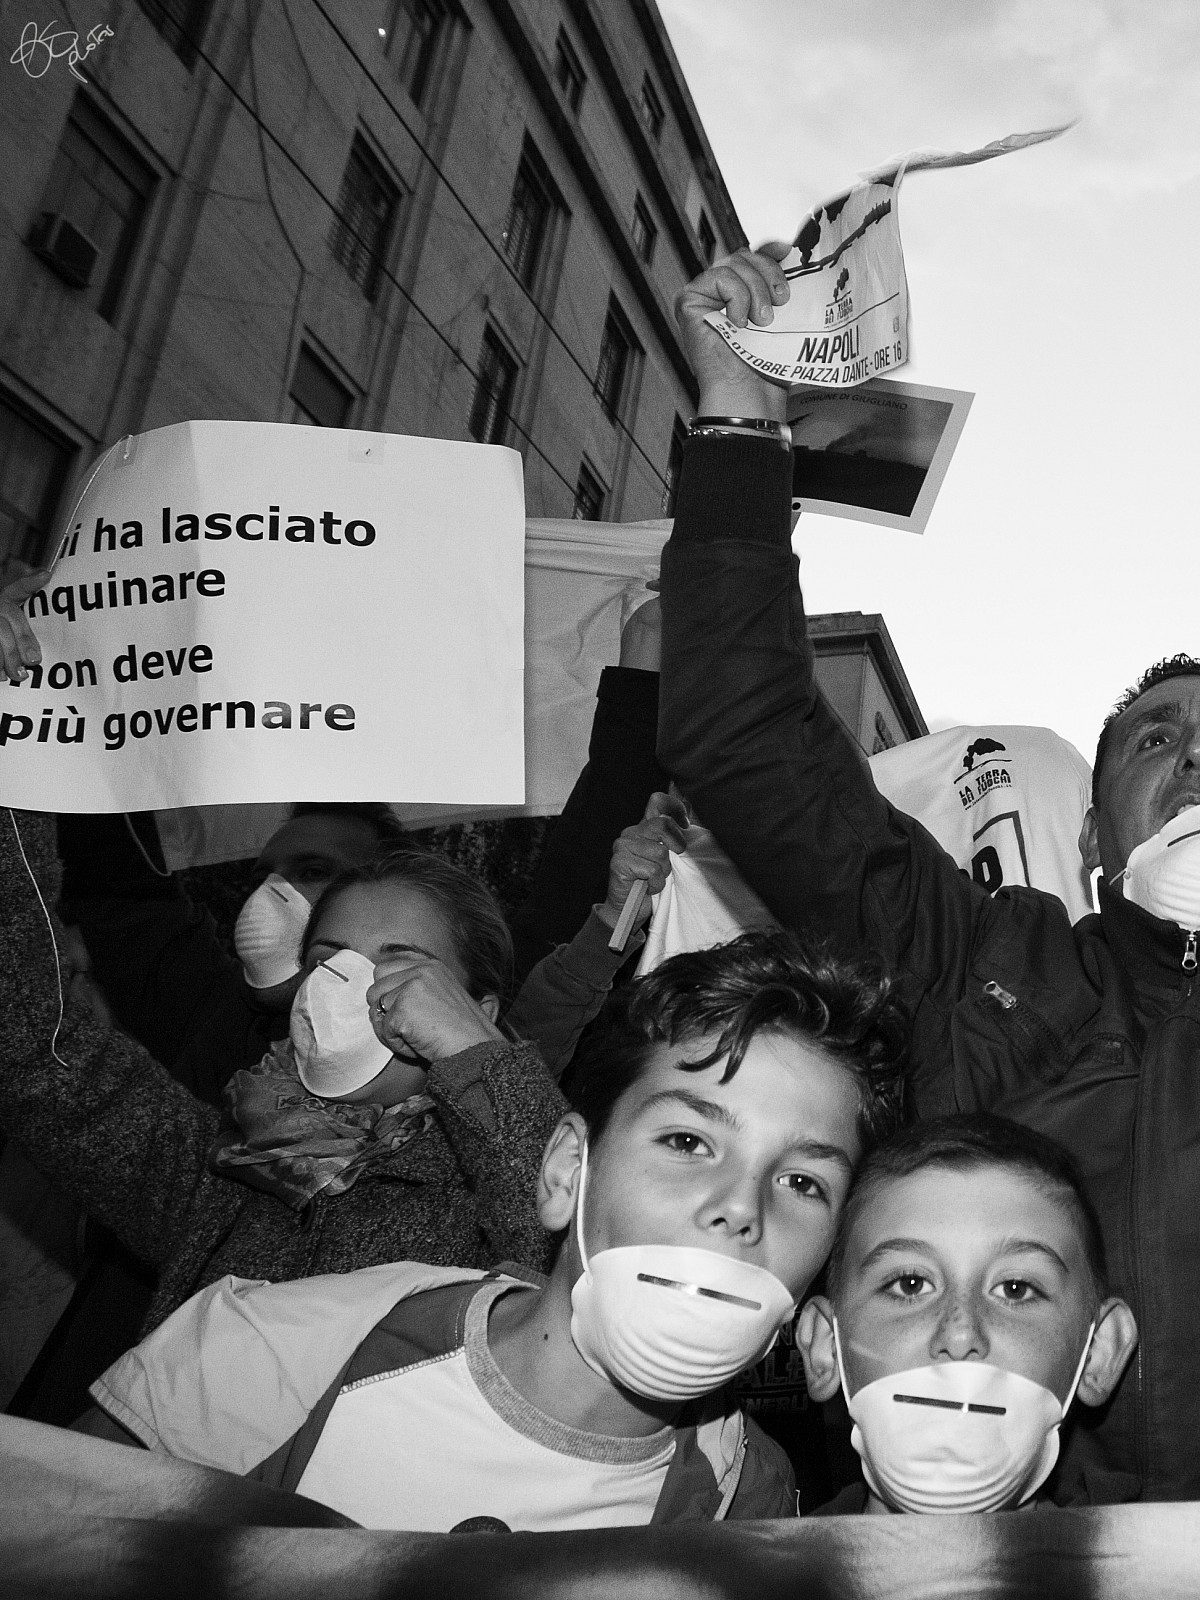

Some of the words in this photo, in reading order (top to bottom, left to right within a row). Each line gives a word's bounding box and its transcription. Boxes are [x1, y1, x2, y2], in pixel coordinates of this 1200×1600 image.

[715, 323, 733, 340] 25
[731, 341, 791, 377] OTTOBRE
[790, 365, 840, 384] PIAZZA
[841, 356, 869, 383] DANTE
[874, 345, 891, 371] ORE
[893, 339, 902, 361] 16
[796, 325, 860, 364] NAPOLI
[839, 392, 851, 400] DI
[852, 394, 909, 411] GIUGLIANO
[93, 517, 143, 553] ha
[161, 505, 376, 548] lasciato
[113, 643, 213, 683] deve
[0, 705, 86, 746] più
[103, 697, 356, 751] governare
[975, 768, 1010, 786] TERRA
[977, 775, 1012, 796] FUOCHI
